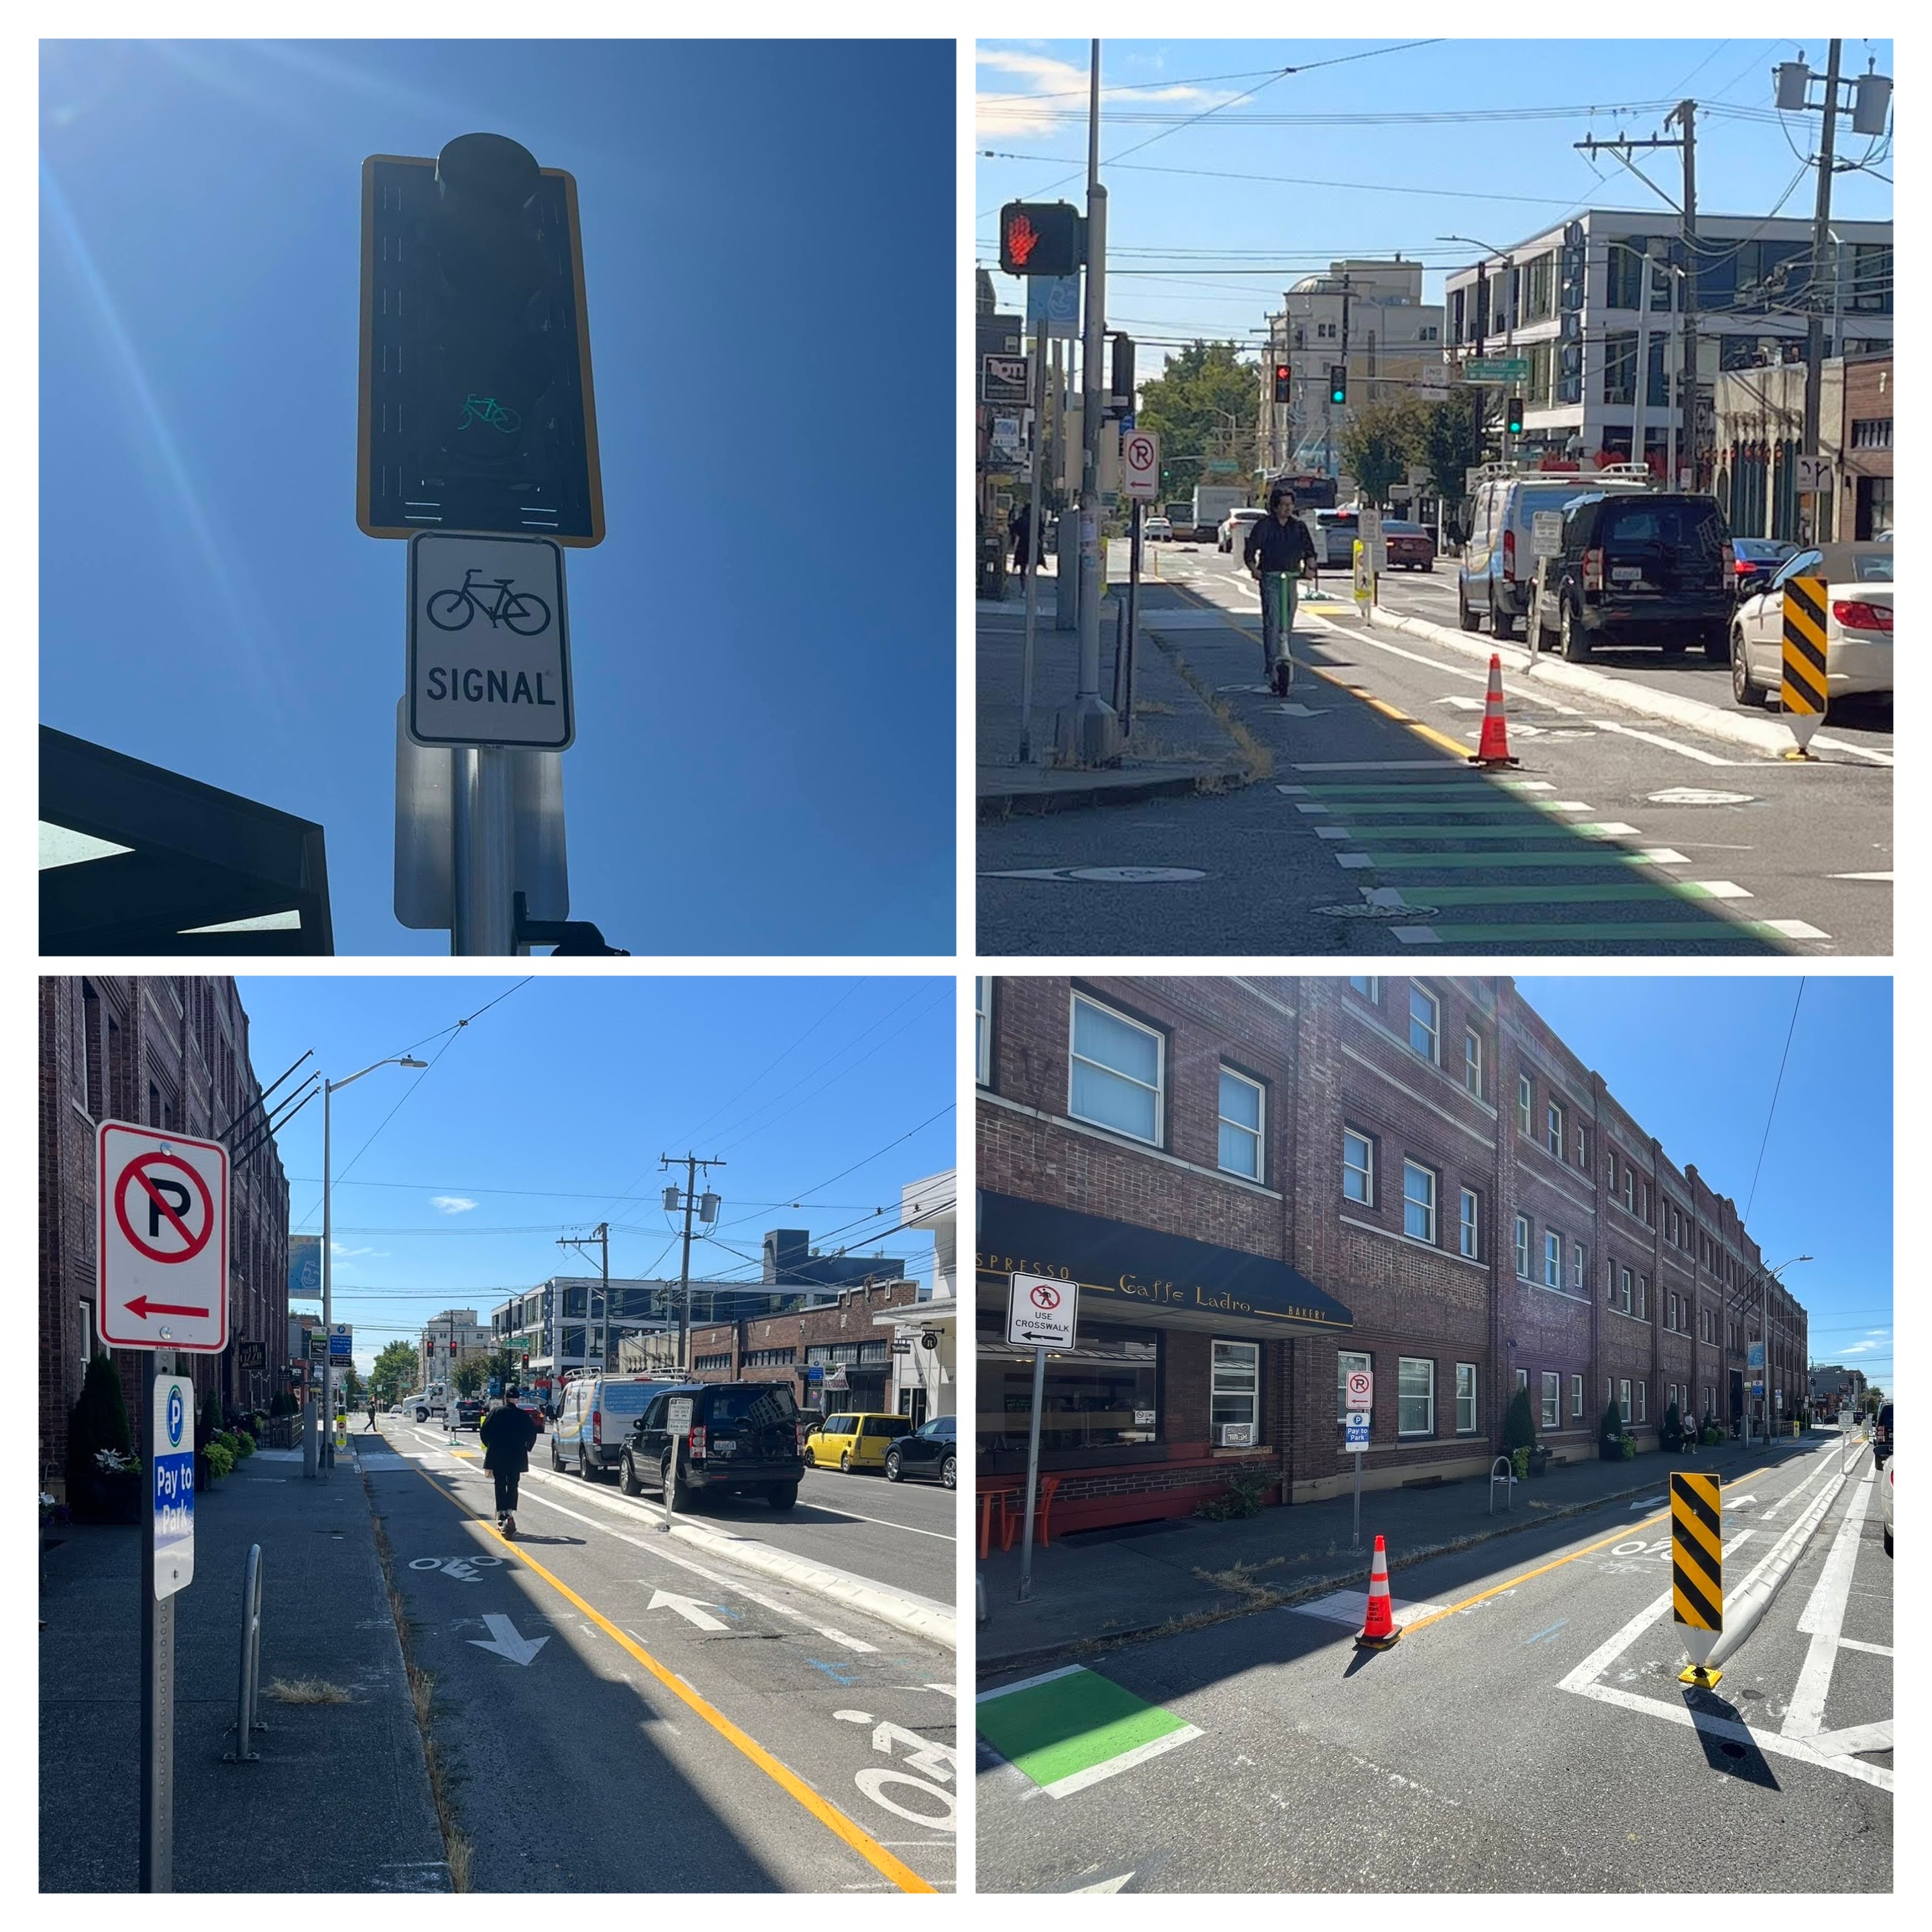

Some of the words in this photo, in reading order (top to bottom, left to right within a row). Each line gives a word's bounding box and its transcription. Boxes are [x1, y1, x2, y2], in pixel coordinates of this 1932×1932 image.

[427, 667, 555, 705] SIGNAL
[1119, 1274, 1184, 1303] Caffe
[1195, 1286, 1250, 1312] Ladro
[1015, 1320, 1069, 1332] CROSSWALK
[1035, 1311, 1053, 1320] USE
[1289, 1305, 1326, 1320] BAKERY
[172, 1399, 180, 1434] P
[158, 1466, 178, 1499] Pay
[181, 1463, 192, 1490] to
[163, 1499, 187, 1534] Park
